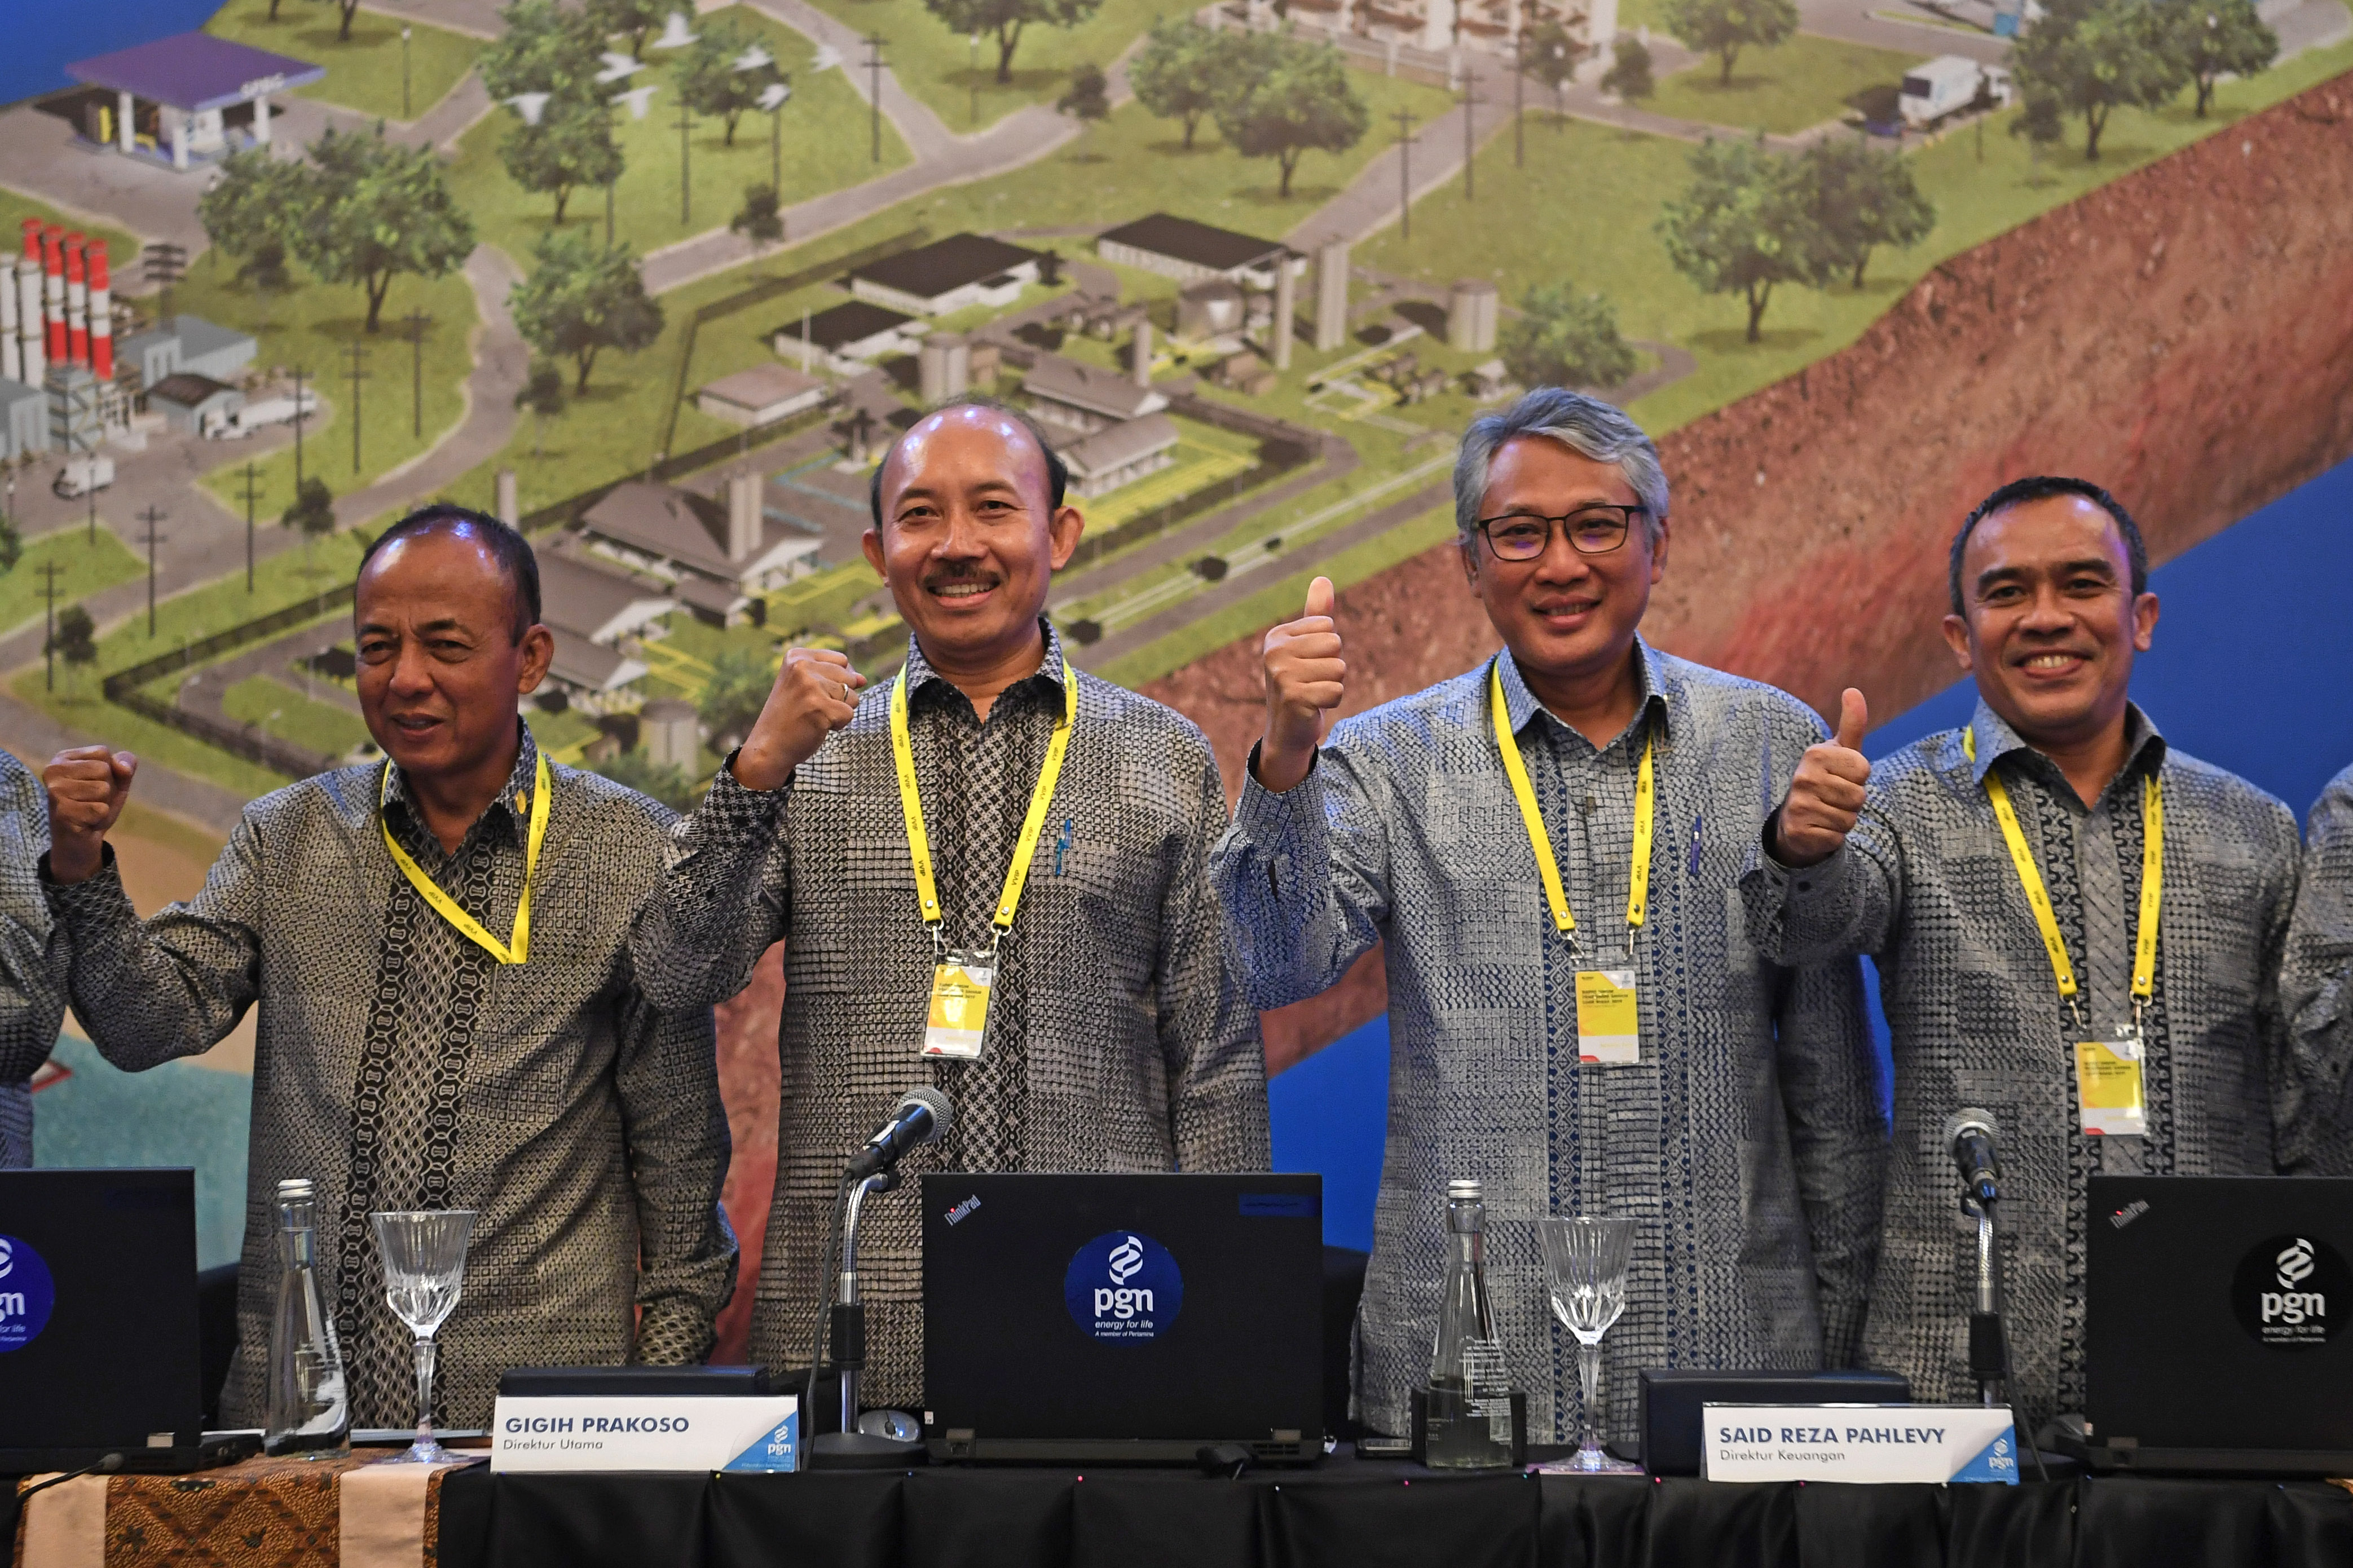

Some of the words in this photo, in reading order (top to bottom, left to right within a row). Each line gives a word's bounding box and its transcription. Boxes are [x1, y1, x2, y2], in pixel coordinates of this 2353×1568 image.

[944, 1194, 981, 1226] ThinkPad
[1095, 1288, 1153, 1319] pgn
[2261, 1292, 2325, 1324] pgn
[1095, 1321, 1125, 1330] energy
[1127, 1320, 1139, 1328] for
[1140, 1320, 1153, 1328] life
[506, 1417, 573, 1433] GIGIH
[582, 1417, 689, 1433] PRAKOSO
[1720, 1427, 1772, 1443] SAID
[1781, 1428, 1839, 1443] REZA
[1846, 1428, 1945, 1443] PAHLEVY
[504, 1439, 556, 1450] Direktur
[560, 1439, 603, 1450] Utama
[768, 1444, 791, 1455] pgn
[1720, 1449, 1773, 1461] Direktur
[1778, 1450, 1845, 1463] Keuangan
